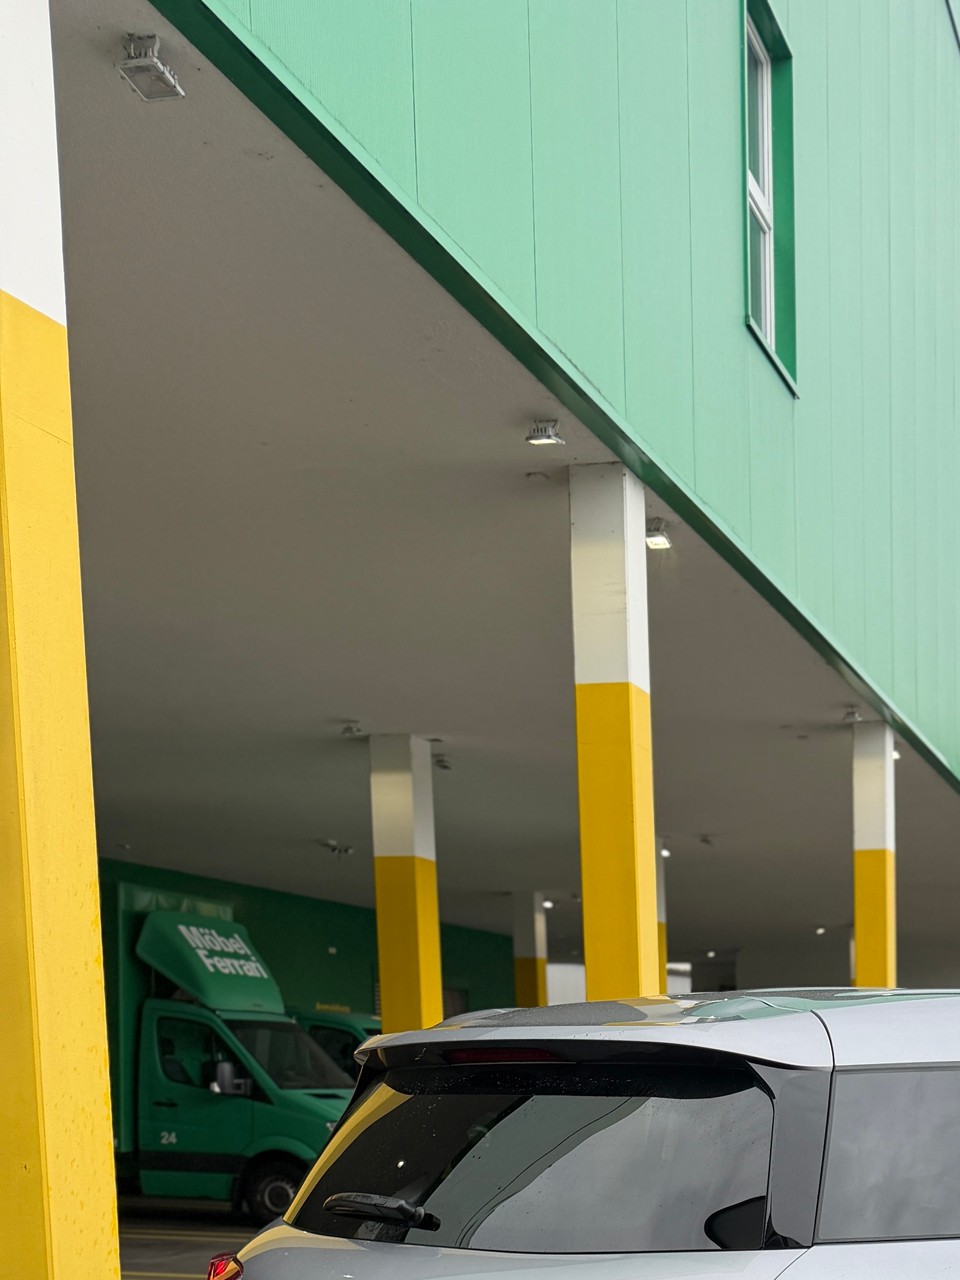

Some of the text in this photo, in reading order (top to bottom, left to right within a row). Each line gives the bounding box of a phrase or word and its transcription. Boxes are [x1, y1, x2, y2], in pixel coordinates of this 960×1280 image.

[178, 924, 252, 955] Möbel
[195, 949, 268, 979] Ferrari
[160, 1131, 177, 1144] 24
